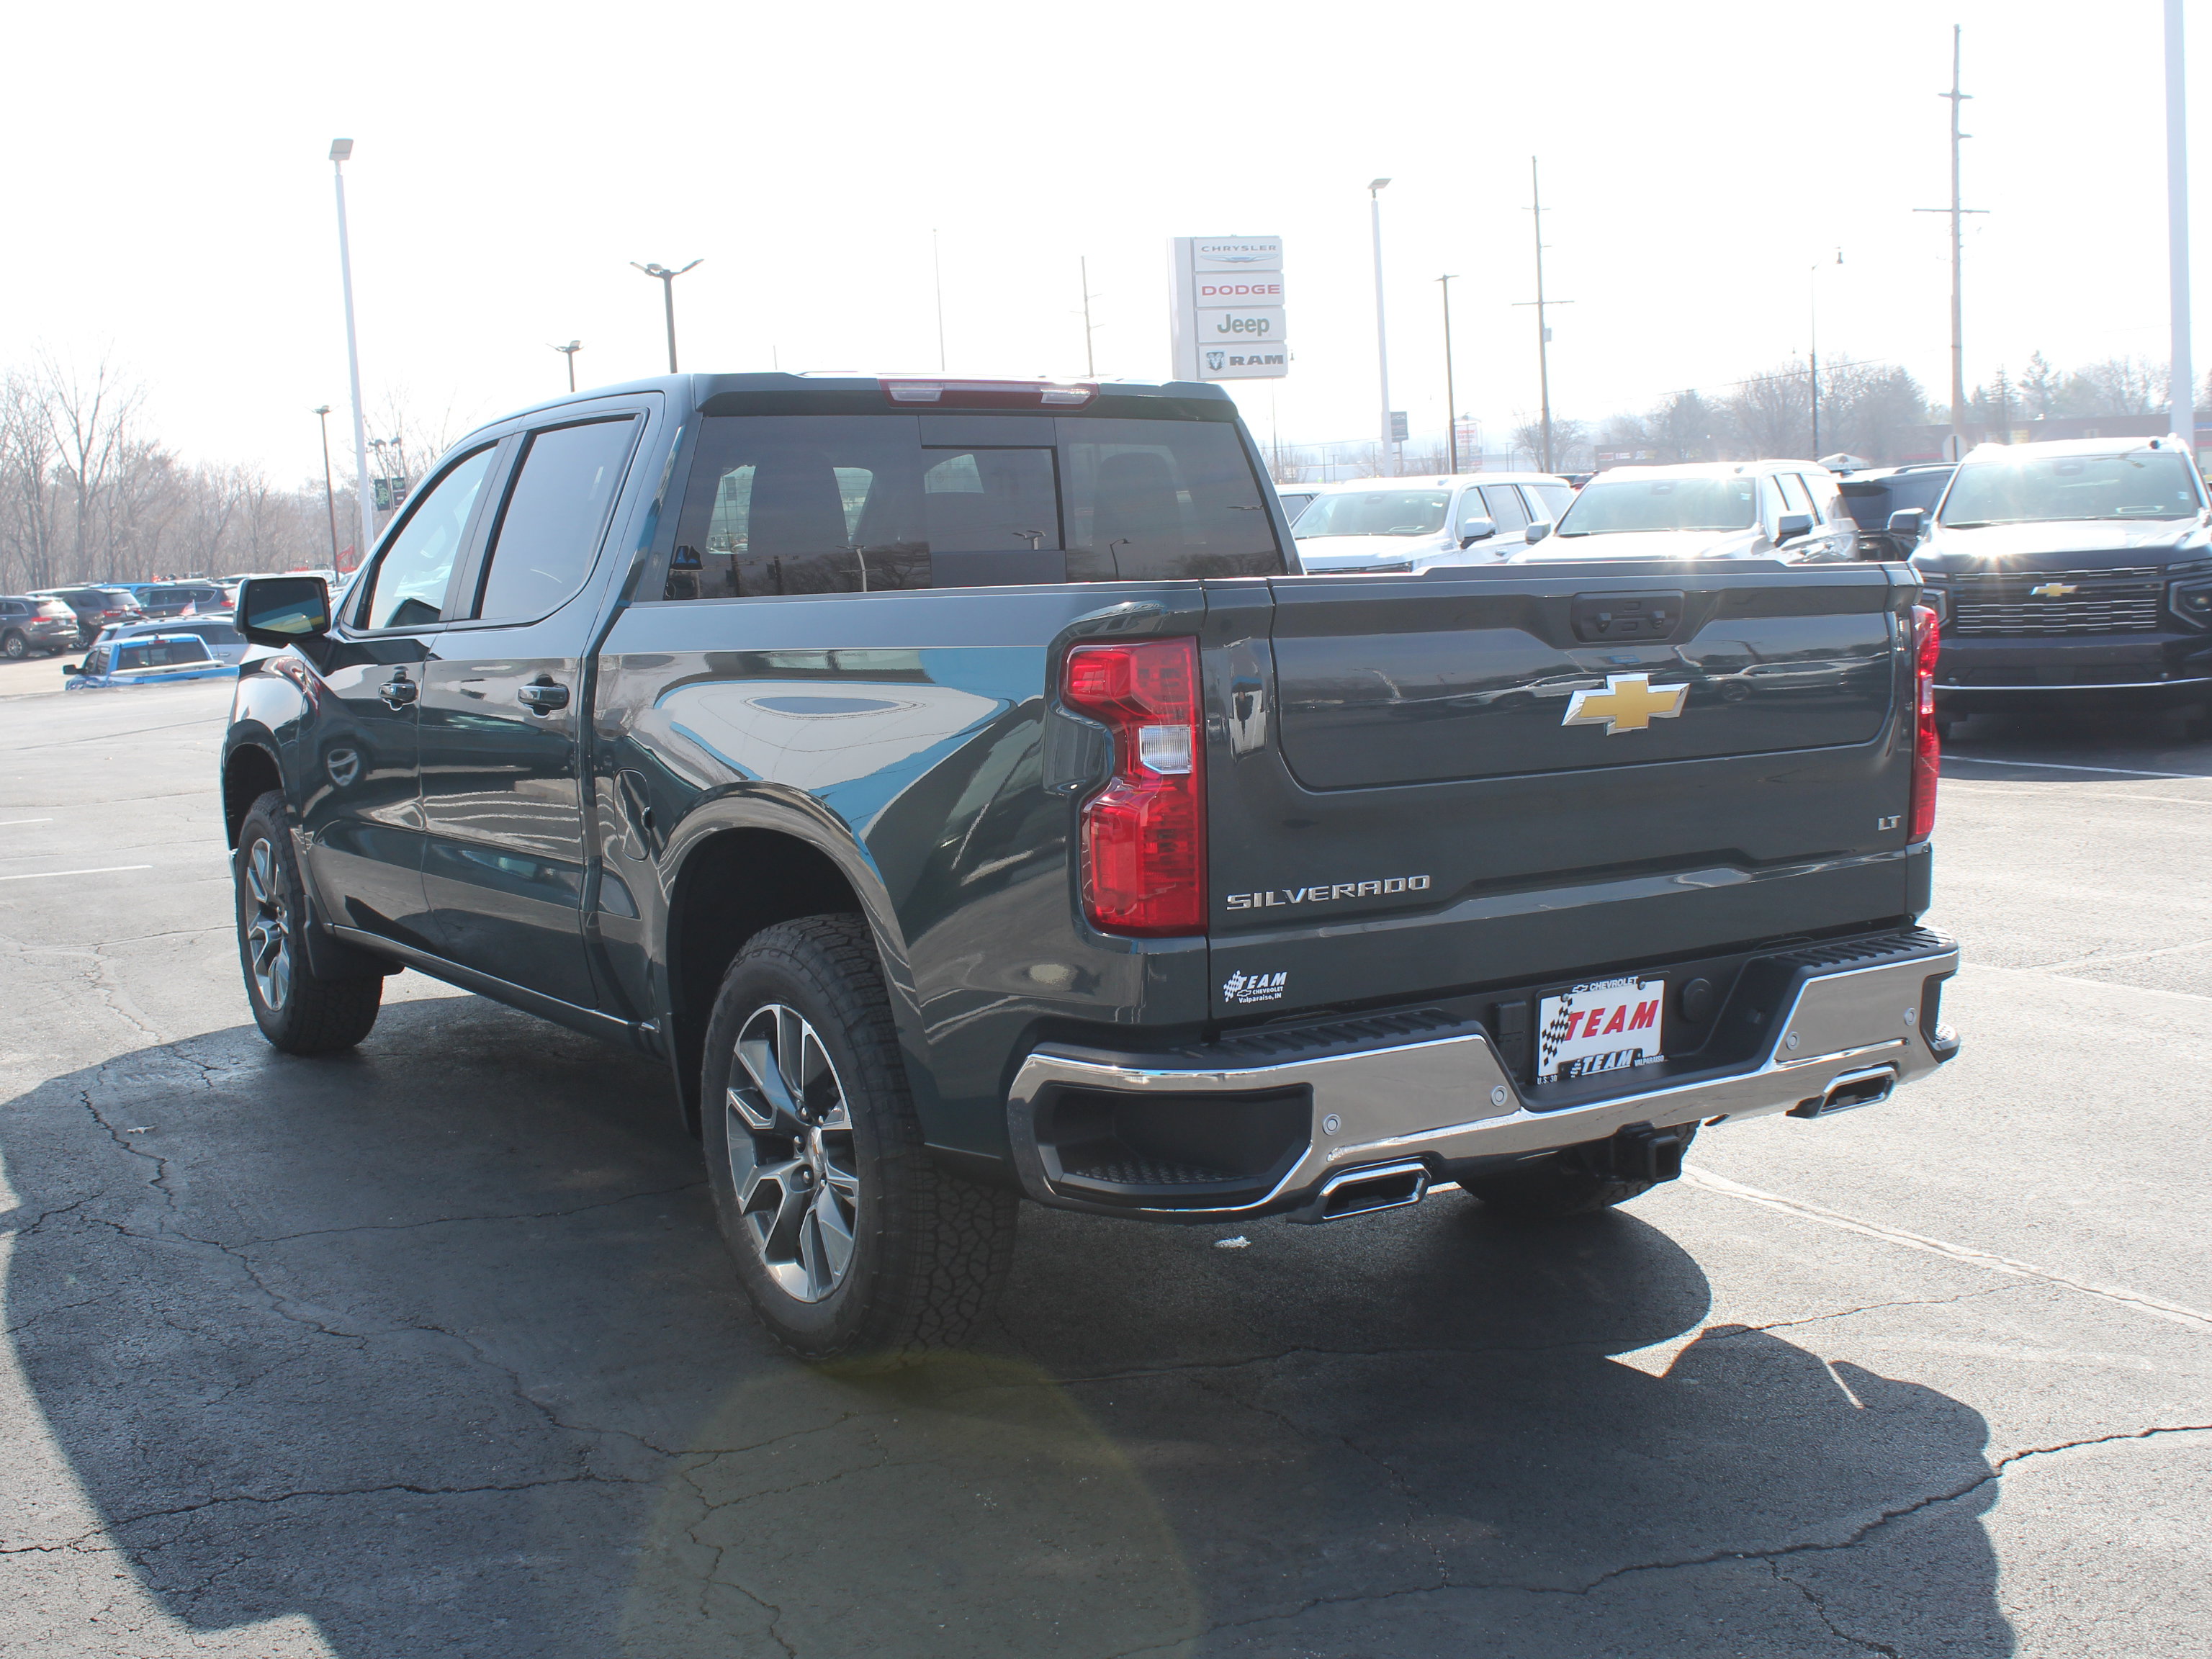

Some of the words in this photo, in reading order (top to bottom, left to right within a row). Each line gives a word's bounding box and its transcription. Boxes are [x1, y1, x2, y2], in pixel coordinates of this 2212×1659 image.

[1202, 284, 1280, 296] DODGE
[1217, 314, 1270, 336] Jeep
[1229, 355, 1284, 366] RAM
[1877, 815, 1902, 831] LT
[1226, 875, 1431, 911] SILVERADO
[1236, 971, 1287, 991] TEAM
[1589, 976, 1639, 992] CHEVROLET
[1252, 986, 1284, 995] CHEVROLET
[1238, 994, 1274, 1004] Valparaiso,
[1563, 999, 1660, 1041] TEAM
[1581, 1049, 1635, 1074] TEAM
[1537, 1076, 1549, 1085] U.S.
[1550, 1074, 1557, 1083] 30
